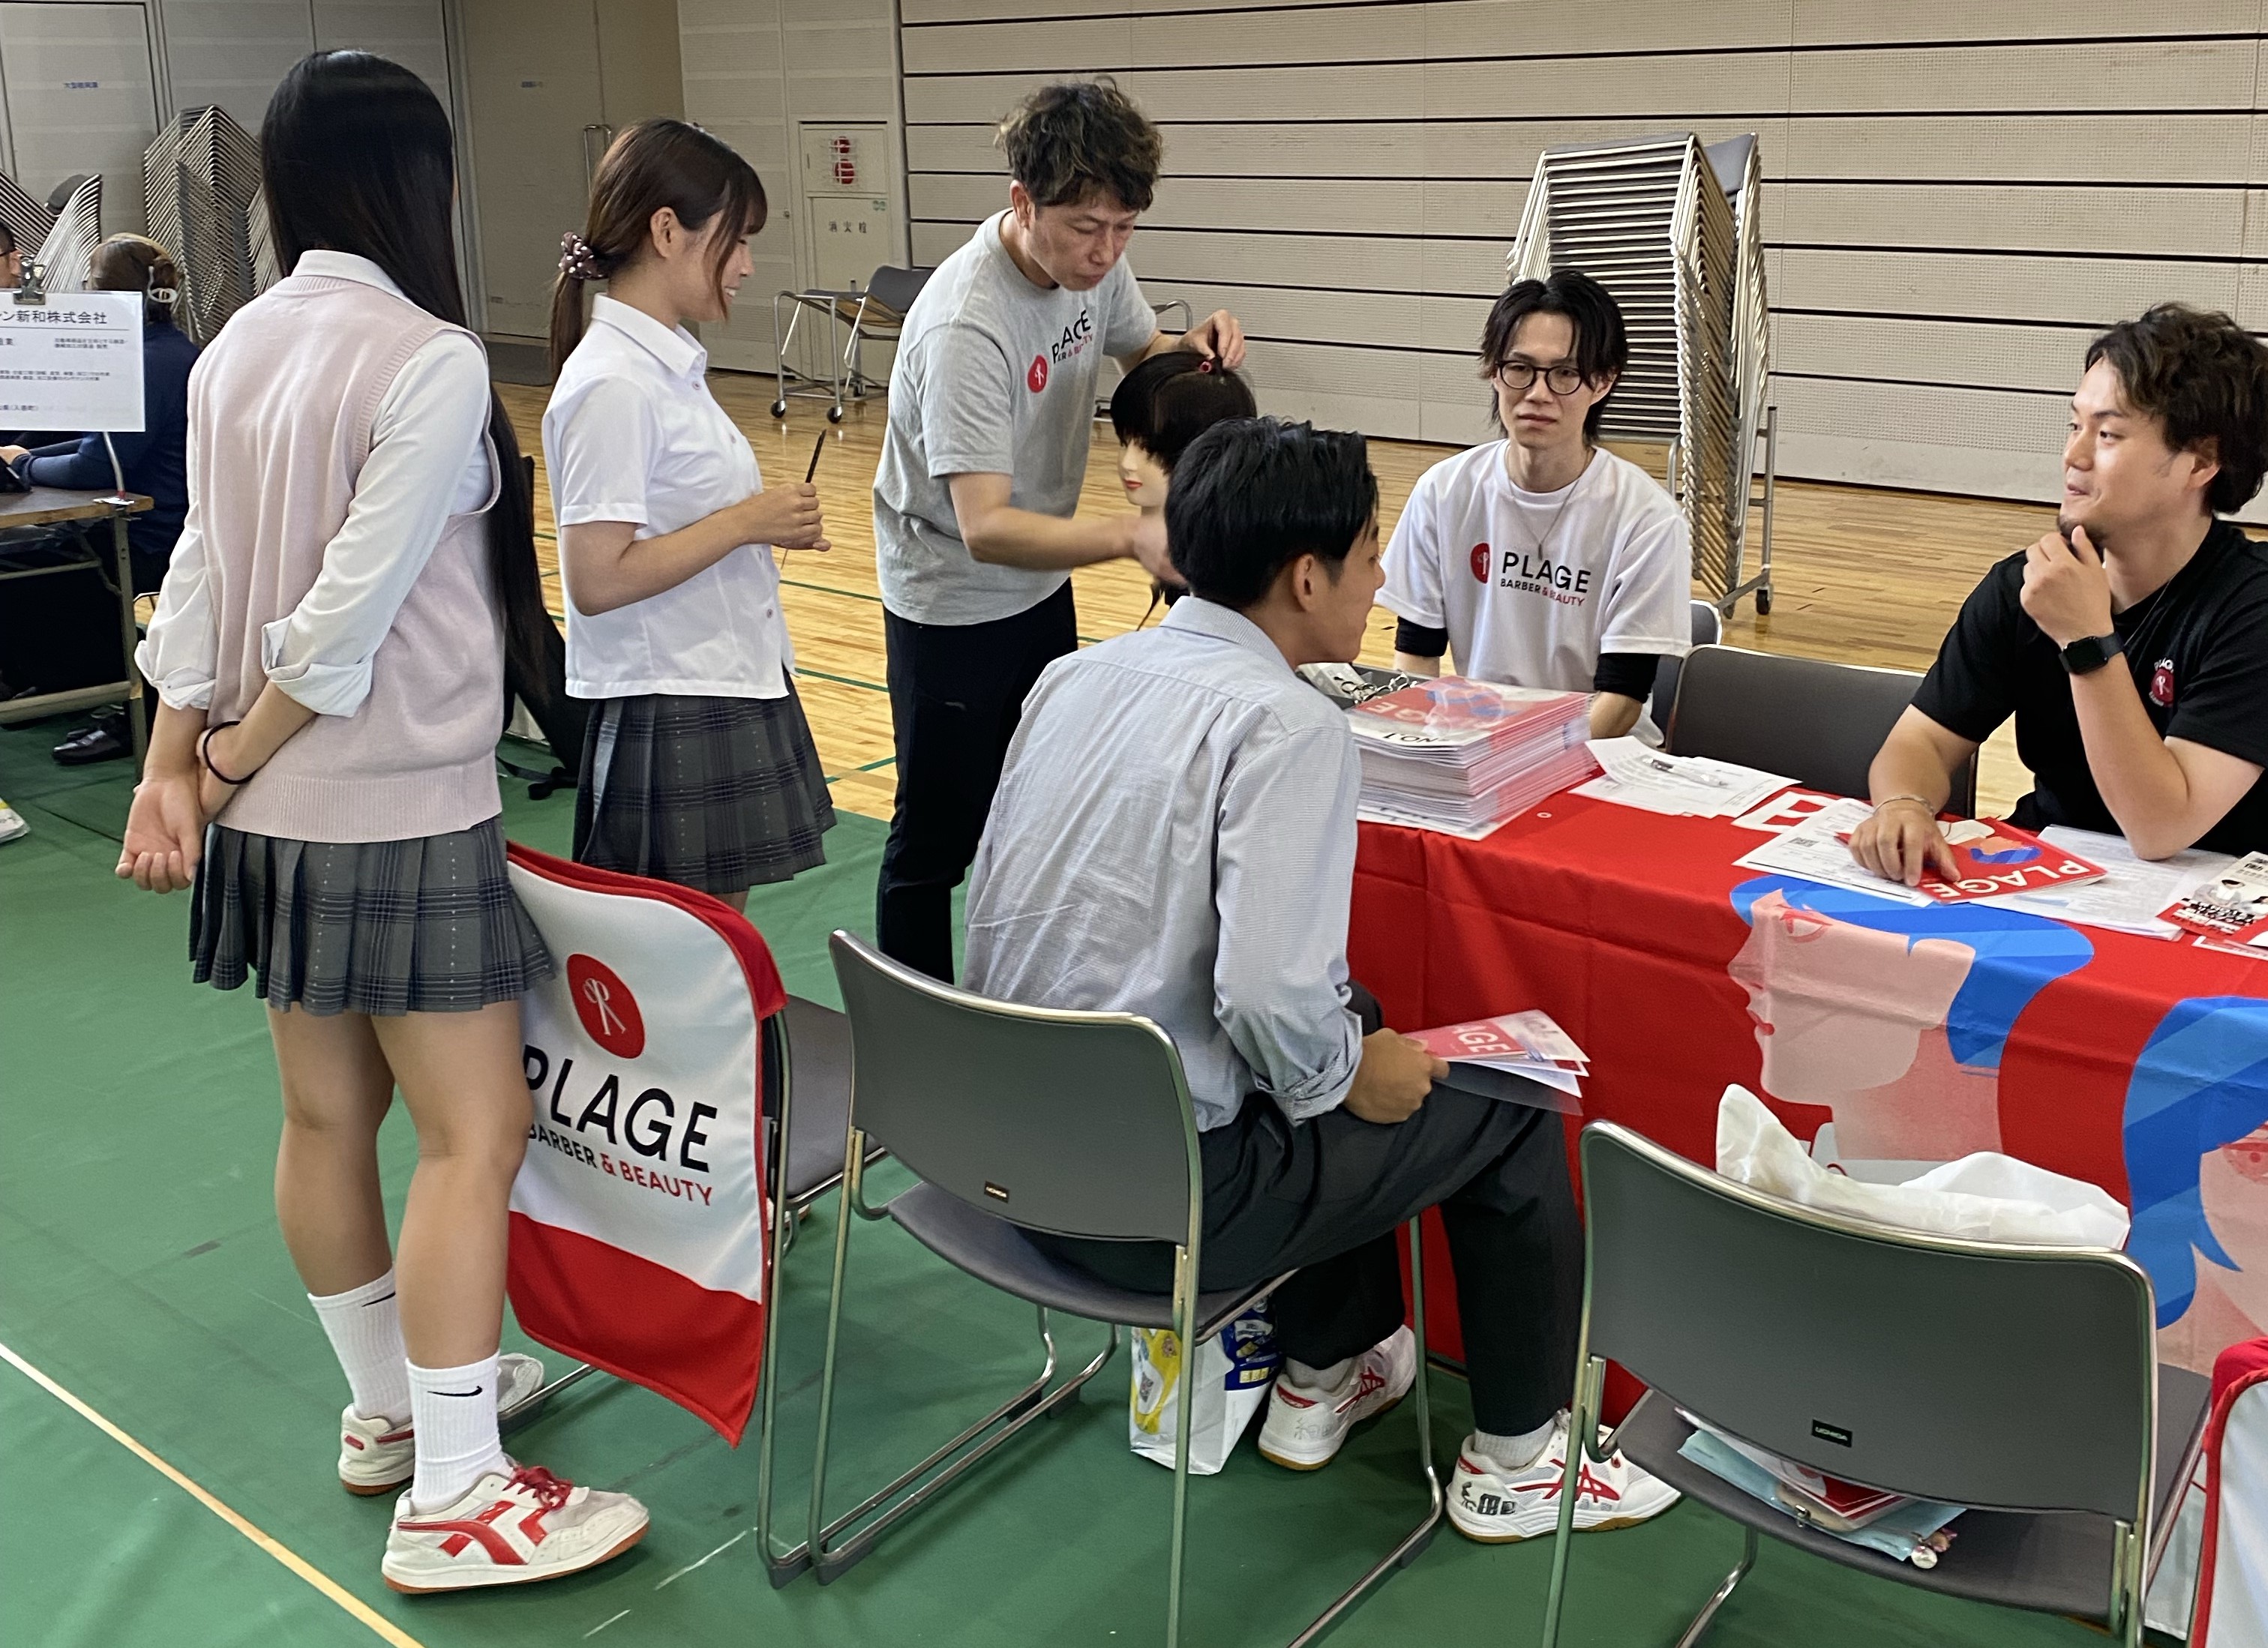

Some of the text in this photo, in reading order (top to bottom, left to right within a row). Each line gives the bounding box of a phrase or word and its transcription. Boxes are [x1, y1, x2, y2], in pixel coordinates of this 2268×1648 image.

[0, 310, 107, 324] ン新和株式会社
[1502, 551, 1591, 593] PLAGE
[1500, 578, 1585, 607] BARBER & BEAUTY
[1924, 860, 2091, 897] PLAGE
[524, 1044, 718, 1173] PLAGE
[600, 1152, 617, 1177] &
[619, 1160, 712, 1206] BEAUTY
